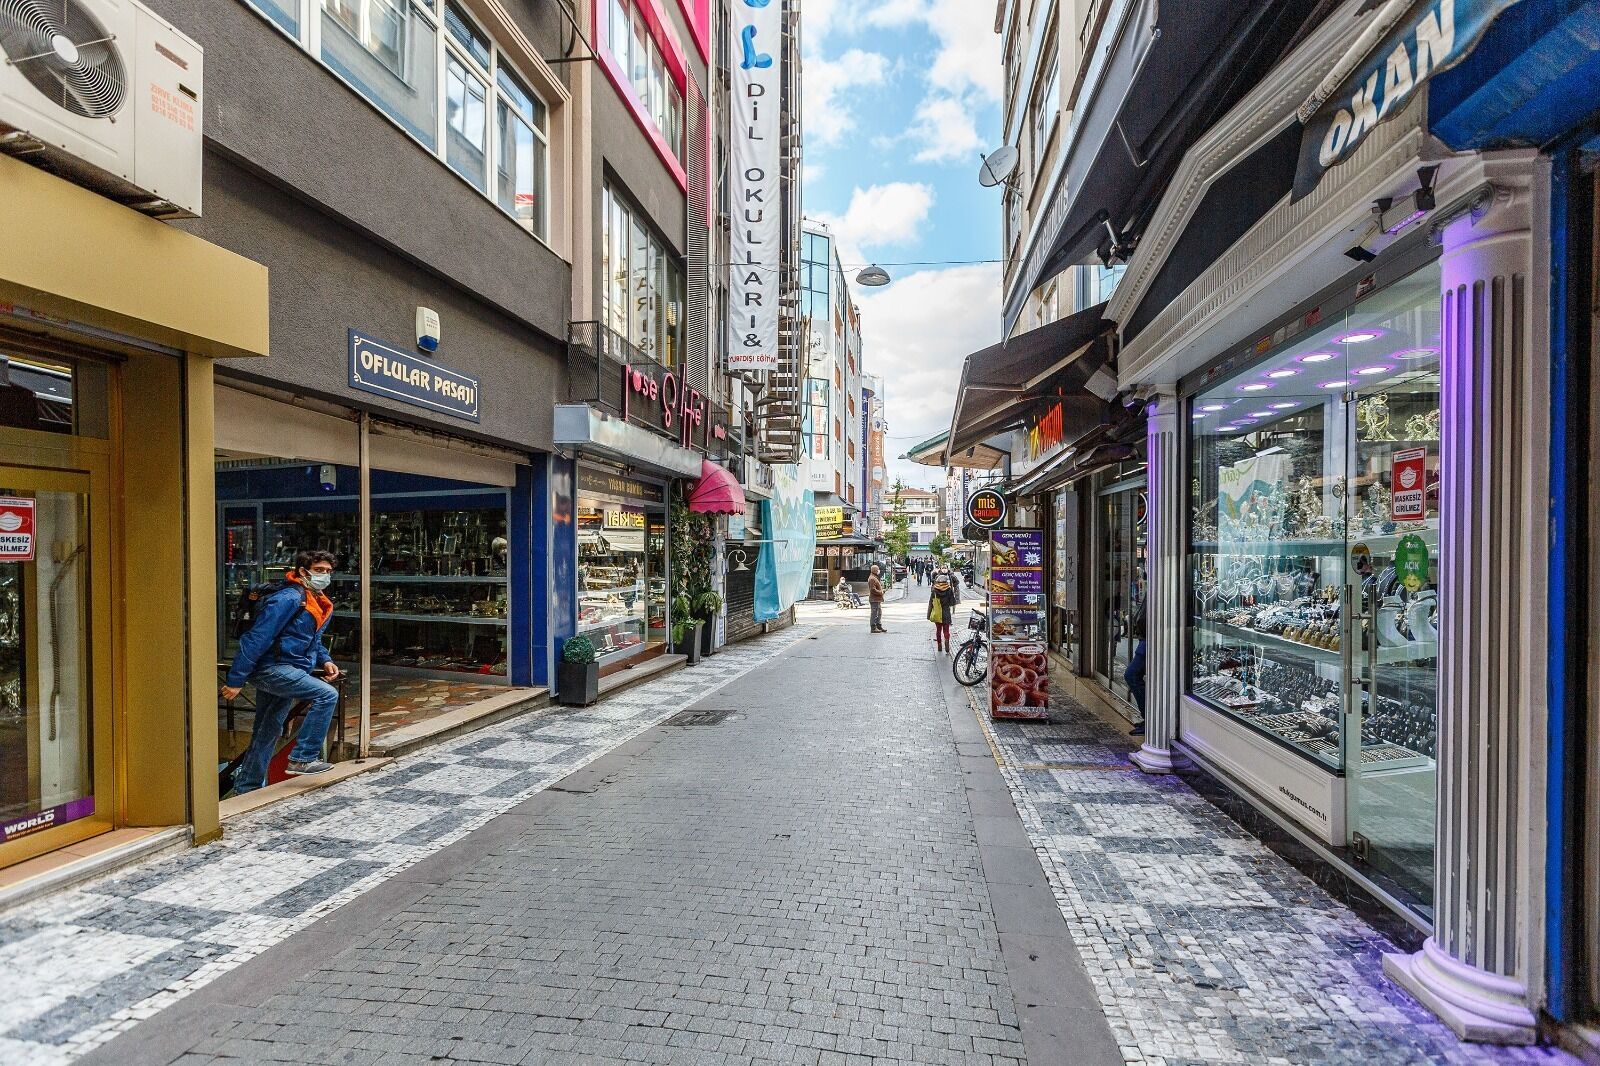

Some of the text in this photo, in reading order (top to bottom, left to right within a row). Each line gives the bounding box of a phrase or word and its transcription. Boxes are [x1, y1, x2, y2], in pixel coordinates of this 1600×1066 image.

[1319, 0, 1454, 166] OKAN
[747, 83, 766, 140] DİL
[361, 350, 474, 405] OFLULAR PASAJI
[978, 495, 996, 508] mis
[1395, 493, 1421, 503] MASKESİZ
[1396, 503, 1420, 513] GİRİLMEZ
[1404, 561, 1419, 570] AÇIK
[4, 813, 55, 835] WORLD
